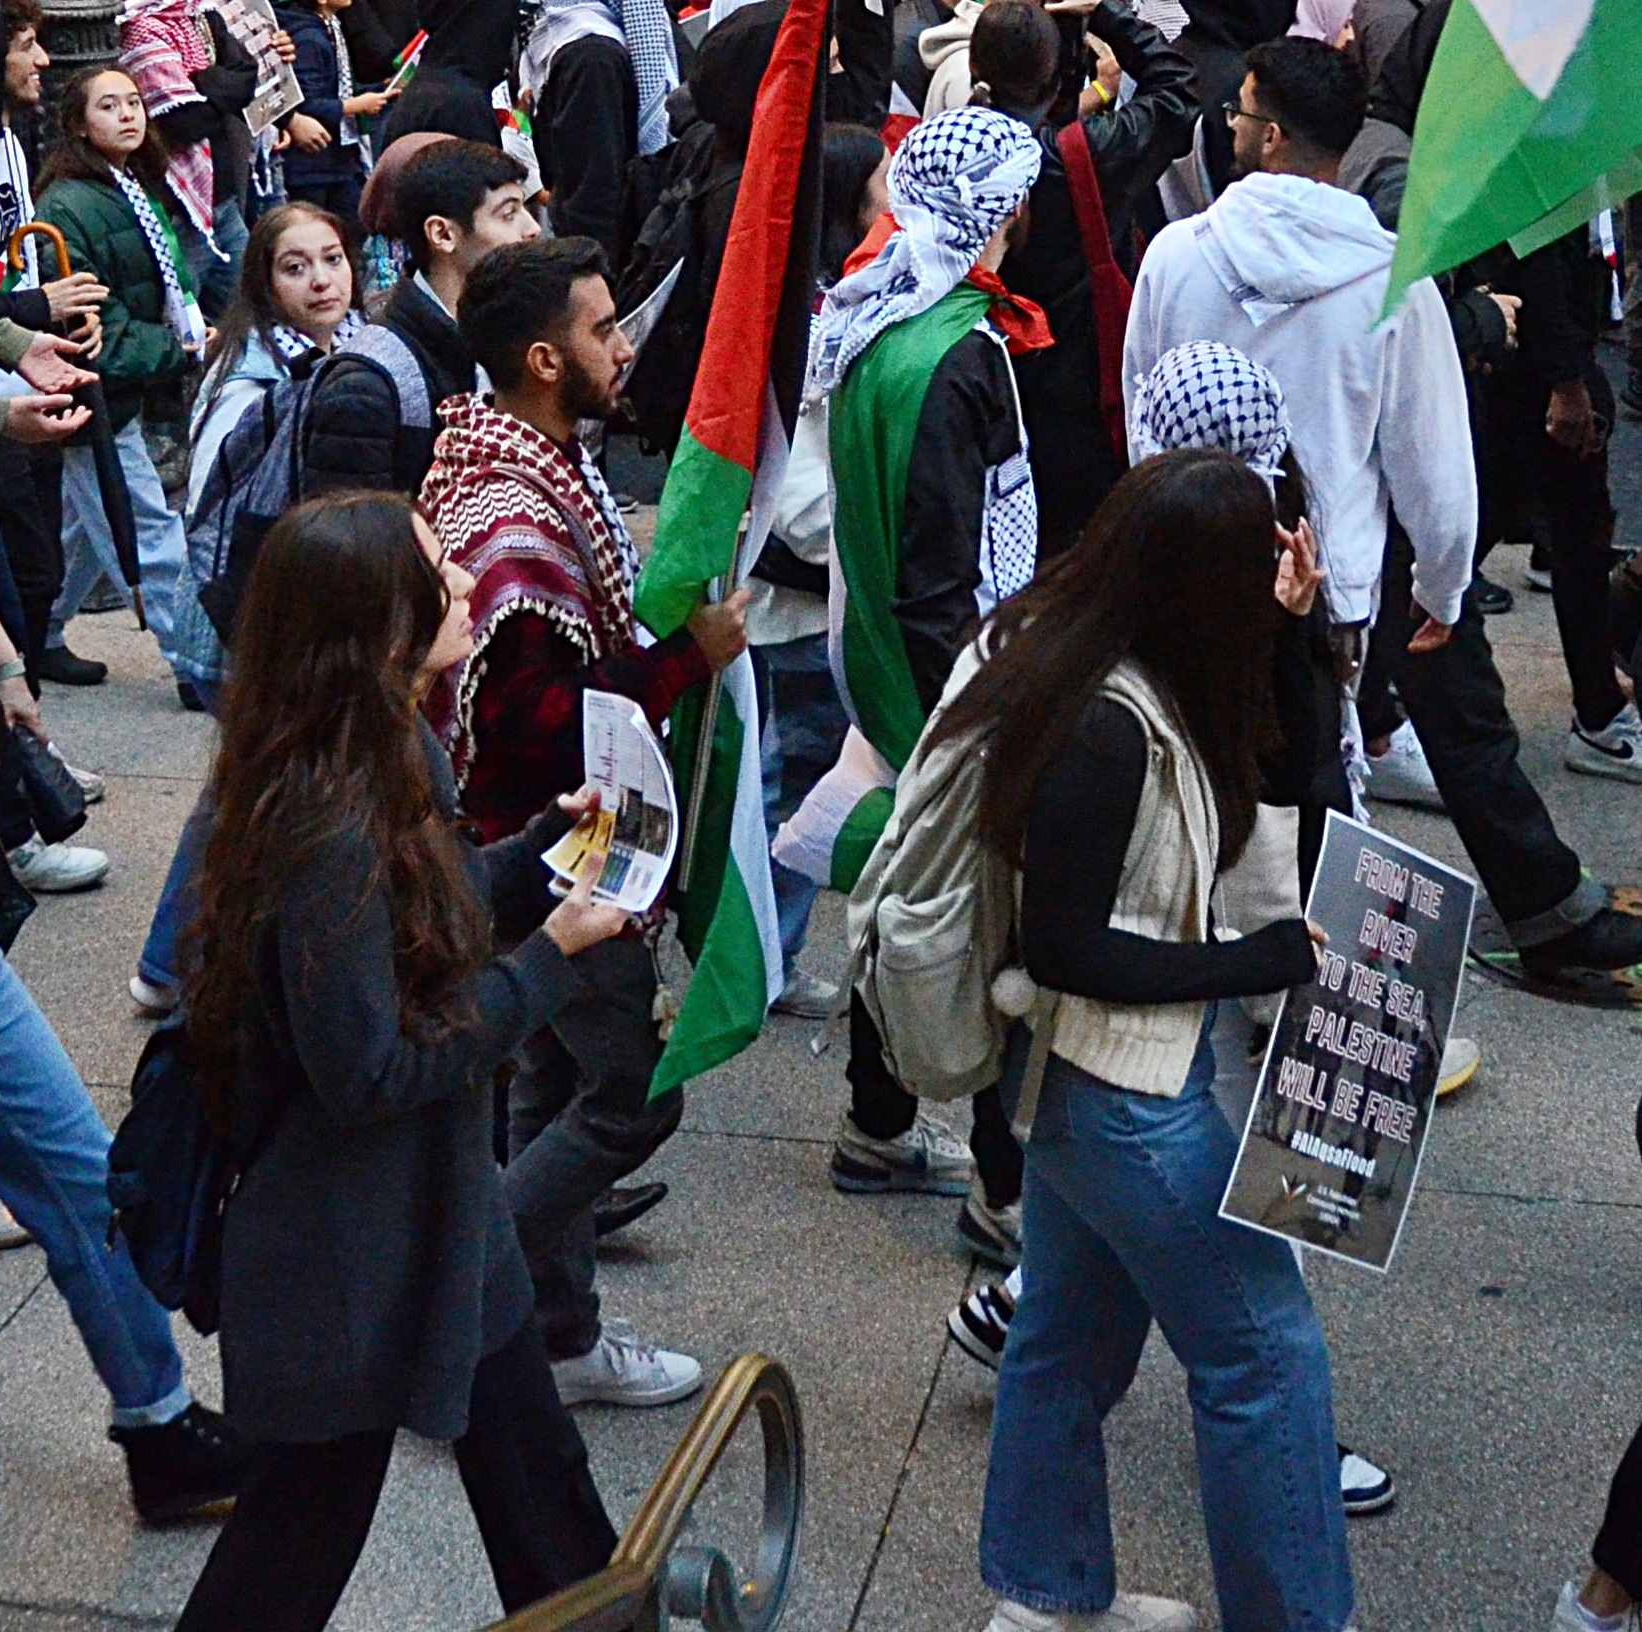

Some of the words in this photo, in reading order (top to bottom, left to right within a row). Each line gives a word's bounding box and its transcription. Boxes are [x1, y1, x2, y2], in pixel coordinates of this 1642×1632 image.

[1355, 846, 1409, 903] FROM
[1411, 872, 1445, 919] THE
[1359, 908, 1418, 965] RIVER
[1318, 948, 1347, 992] TO
[1348, 960, 1387, 1009] THE
[1386, 979, 1427, 1032] SEA,
[1305, 1005, 1418, 1083] PALESTINE
[1277, 1056, 1328, 1113] WILL
[1331, 1077, 1364, 1124] BE
[1361, 1089, 1418, 1145] FREE
